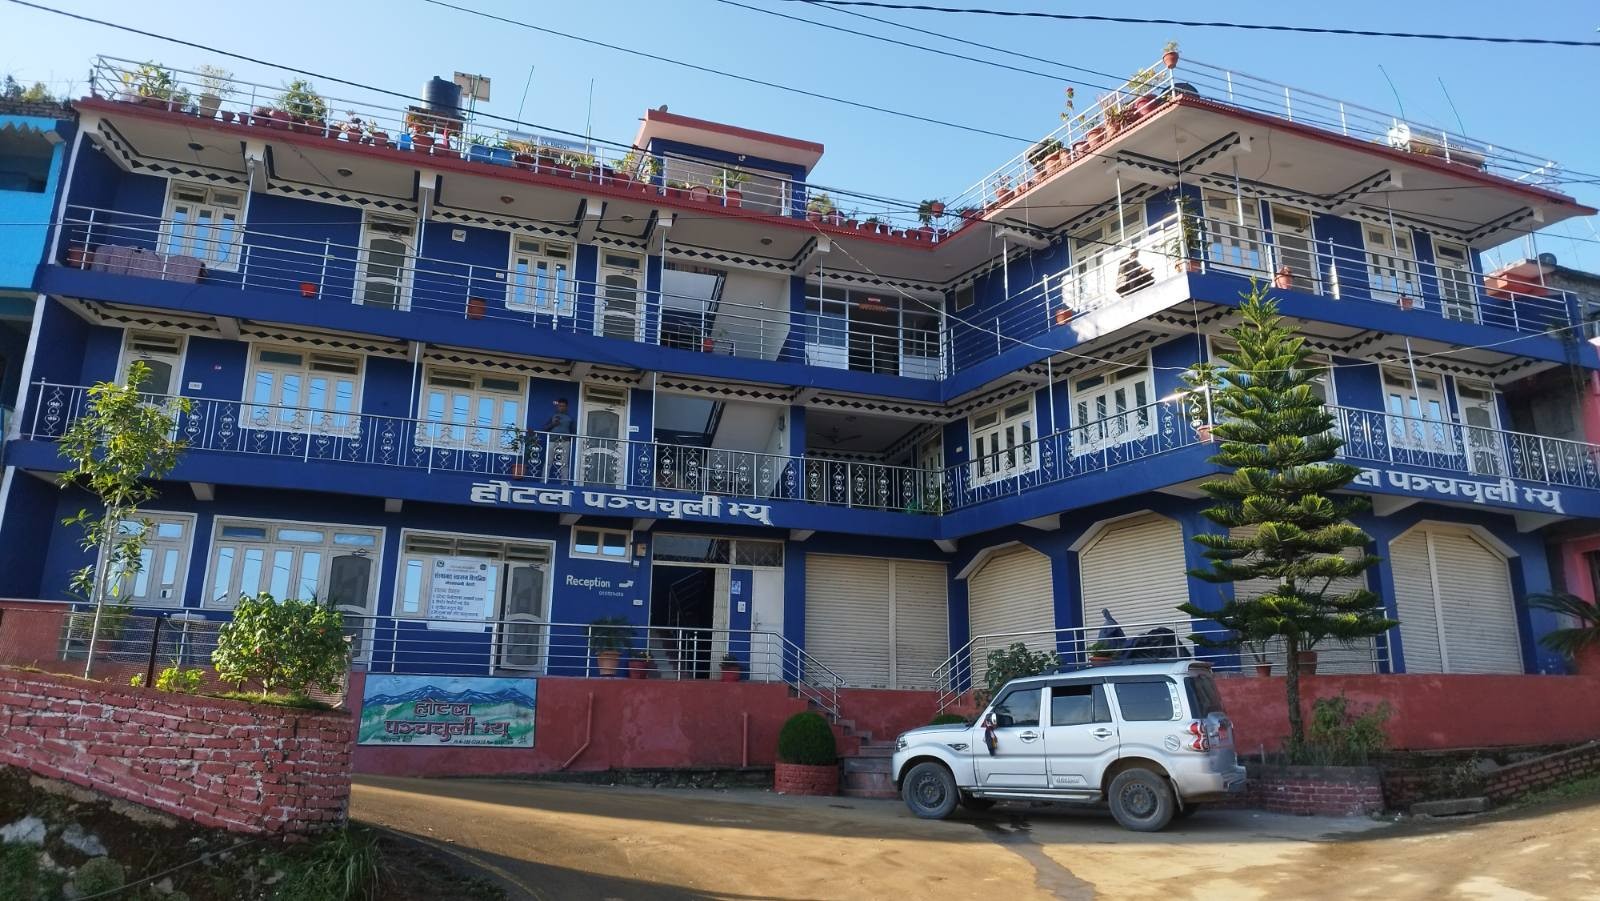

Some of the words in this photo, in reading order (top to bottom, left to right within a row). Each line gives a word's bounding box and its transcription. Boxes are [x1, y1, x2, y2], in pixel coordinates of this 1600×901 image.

[470, 480, 575, 507] होटल
[566, 574, 611, 590] Reception
[413, 699, 473, 717] होटल
